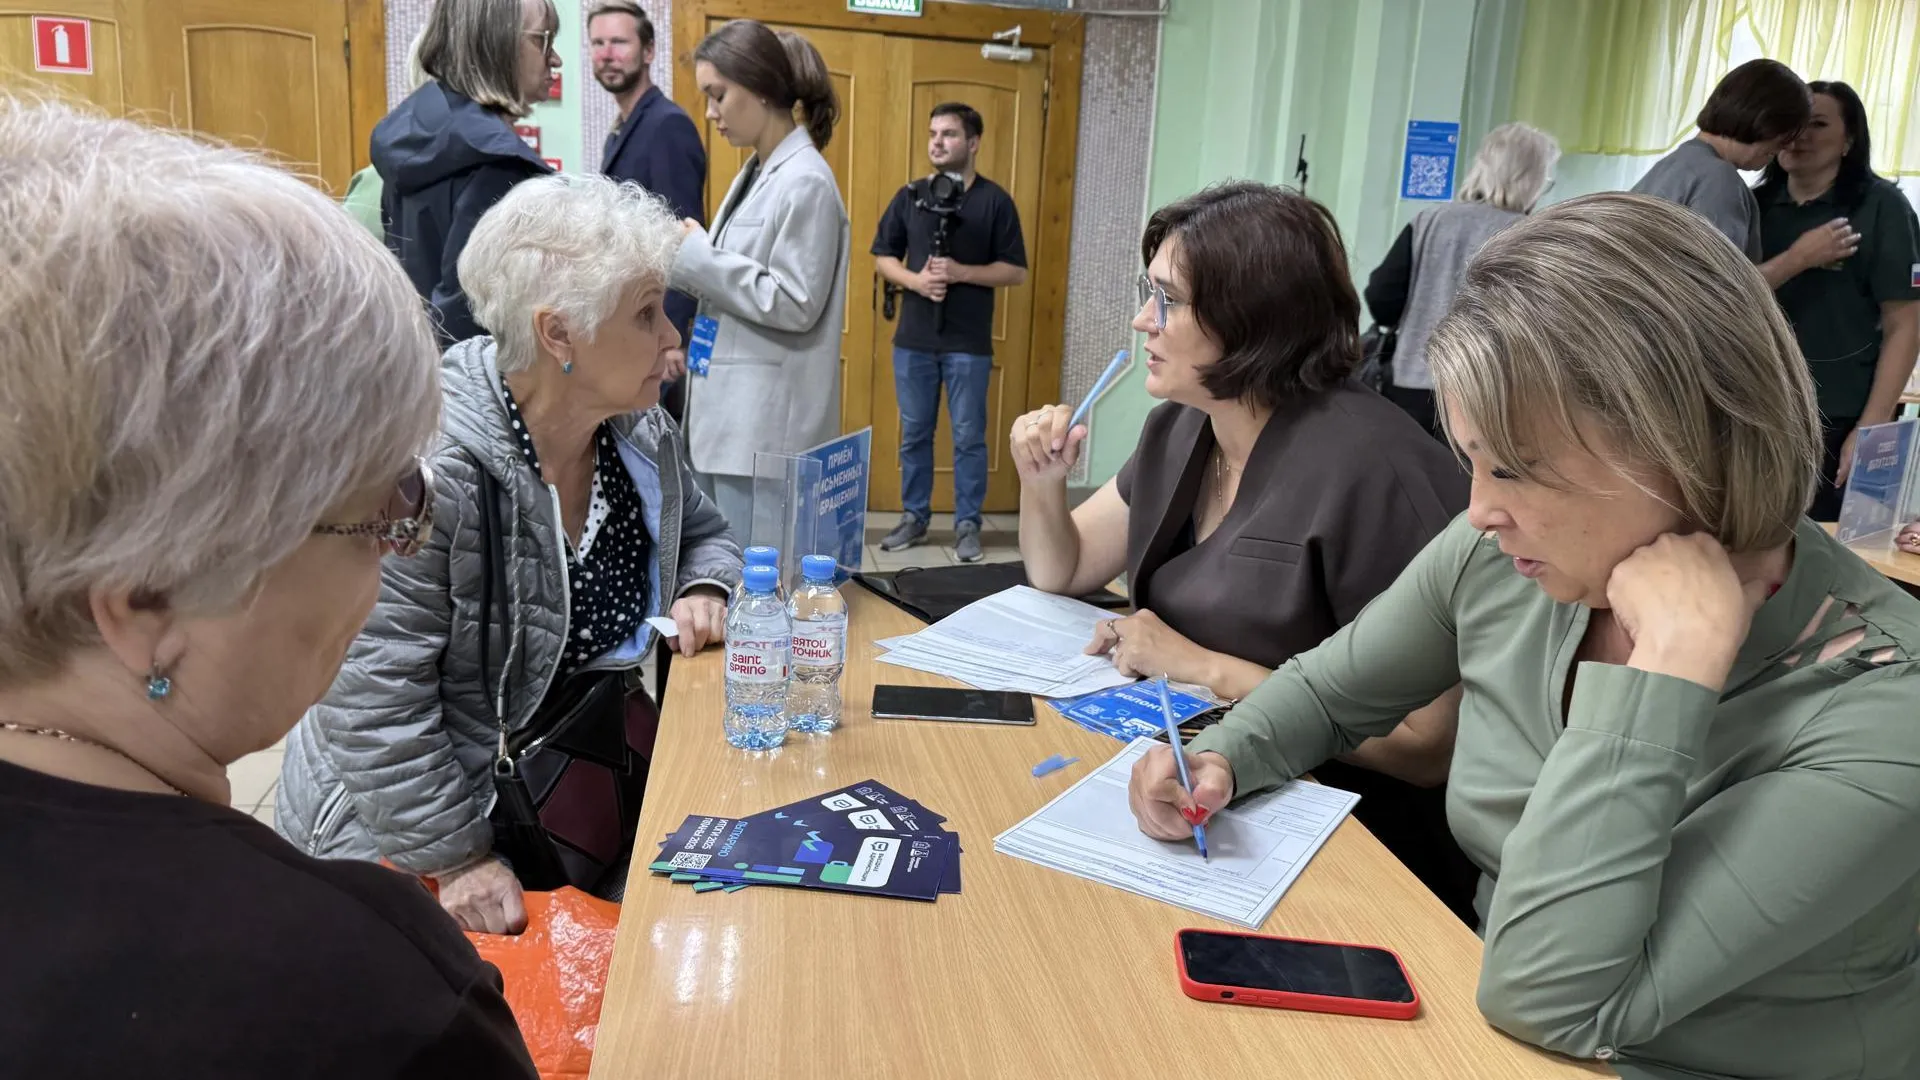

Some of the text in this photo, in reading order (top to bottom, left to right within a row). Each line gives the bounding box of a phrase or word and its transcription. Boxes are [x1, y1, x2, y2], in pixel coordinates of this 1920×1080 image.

[828, 445, 853, 469] ПРИЁМ
[819, 481, 859, 516] БРАЩЕНИЙ
[791, 636, 827, 649] ВЯТОЙ
[791, 646, 833, 659] ТОЧНИК
